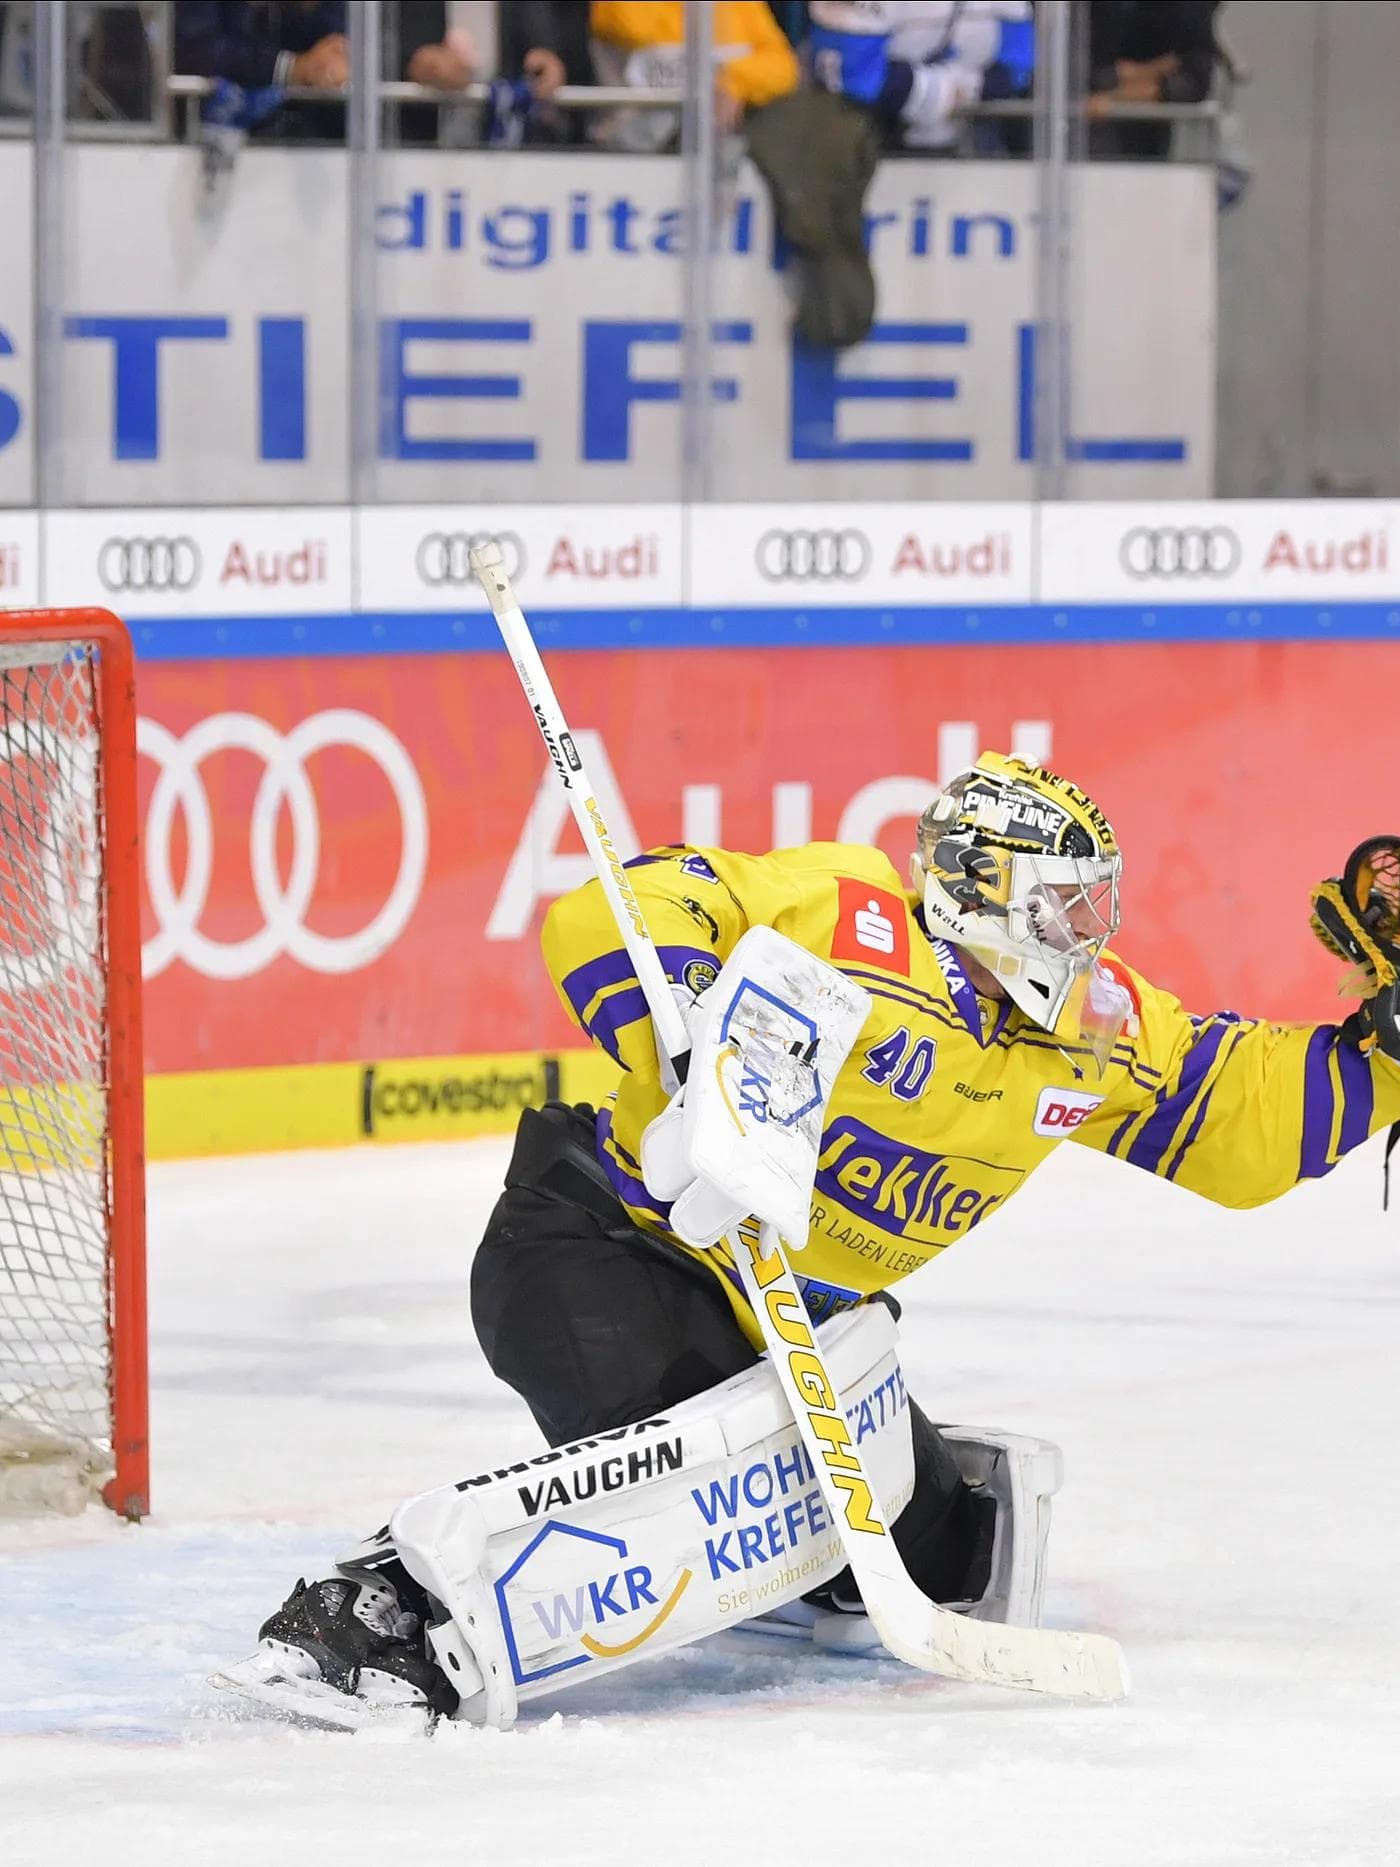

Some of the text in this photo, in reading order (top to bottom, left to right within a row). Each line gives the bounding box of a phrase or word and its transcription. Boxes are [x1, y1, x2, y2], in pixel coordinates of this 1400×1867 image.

[0, 313, 1186, 465] TIEFEL
[219, 540, 327, 585] Audi
[545, 536, 658, 581] Audi
[892, 533, 1011, 578] Audi
[1264, 529, 1389, 573] Audi
[534, 704, 573, 790] VAUGHN
[584, 796, 649, 941] VAUGHN
[860, 1025, 938, 1101] 40
[1041, 1102, 1093, 1128] DE
[827, 1219, 889, 1262] LADEN
[739, 1214, 888, 1536] AUGHN
[518, 1437, 684, 1517] VAUGHN
[704, 1489, 836, 1582] KREFE
[533, 1565, 660, 1641] WKR
[718, 1588, 749, 1614] Sie
